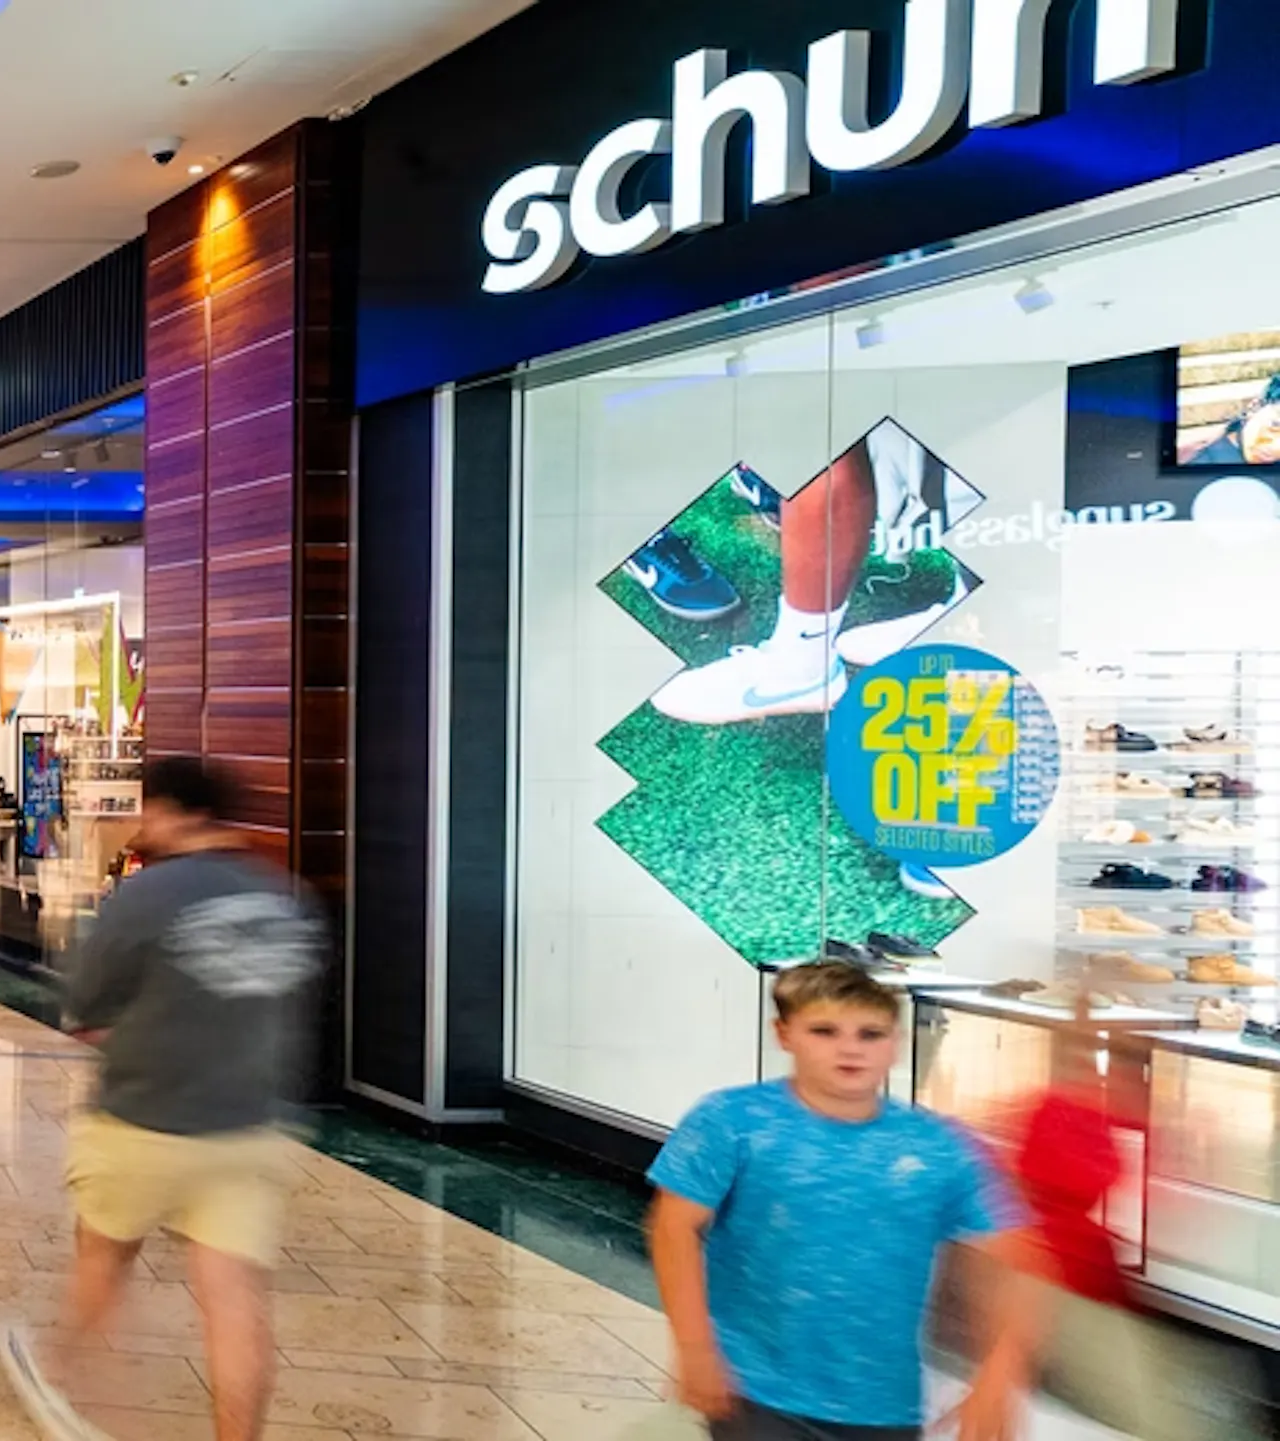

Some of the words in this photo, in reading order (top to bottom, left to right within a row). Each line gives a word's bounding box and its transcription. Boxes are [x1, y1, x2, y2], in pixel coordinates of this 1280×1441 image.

[919, 655, 937, 675] UP
[861, 677, 1018, 755] 25%
[872, 752, 996, 828] OFF
[875, 827, 940, 850] SELECTED
[943, 831, 995, 856] STYLES
